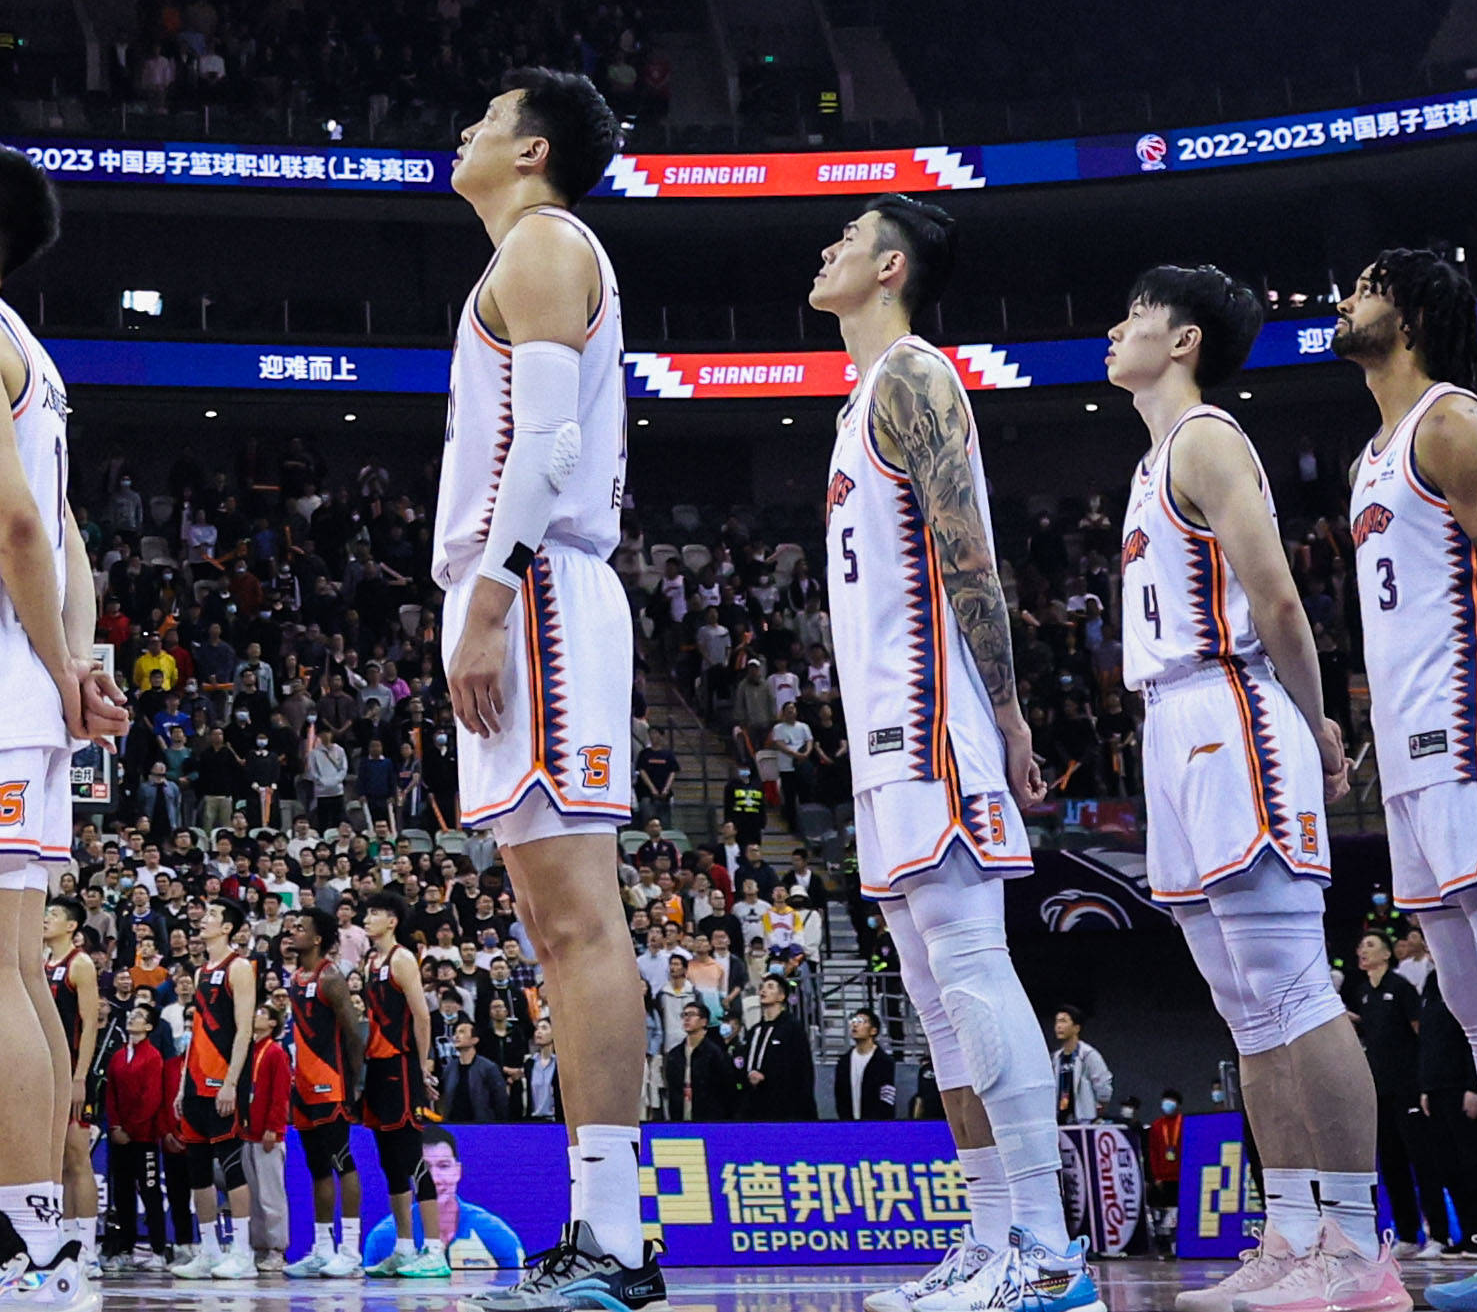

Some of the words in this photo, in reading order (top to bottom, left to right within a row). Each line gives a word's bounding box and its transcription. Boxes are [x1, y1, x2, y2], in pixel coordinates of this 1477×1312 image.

[1178, 122, 1327, 162] 2022-2023
[663, 165, 766, 186] SHANGHAI
[816, 160, 896, 183] SHARKS
[259, 353, 358, 383] 迎难而上
[698, 363, 805, 386] SHANGHAI
[841, 527, 858, 583] 5
[1376, 557, 1397, 610] 3
[1142, 584, 1163, 639] 4
[721, 1159, 973, 1225] 德邦快递
[732, 1229, 850, 1252] DEPPON
[857, 1228, 965, 1251] EXPRES
